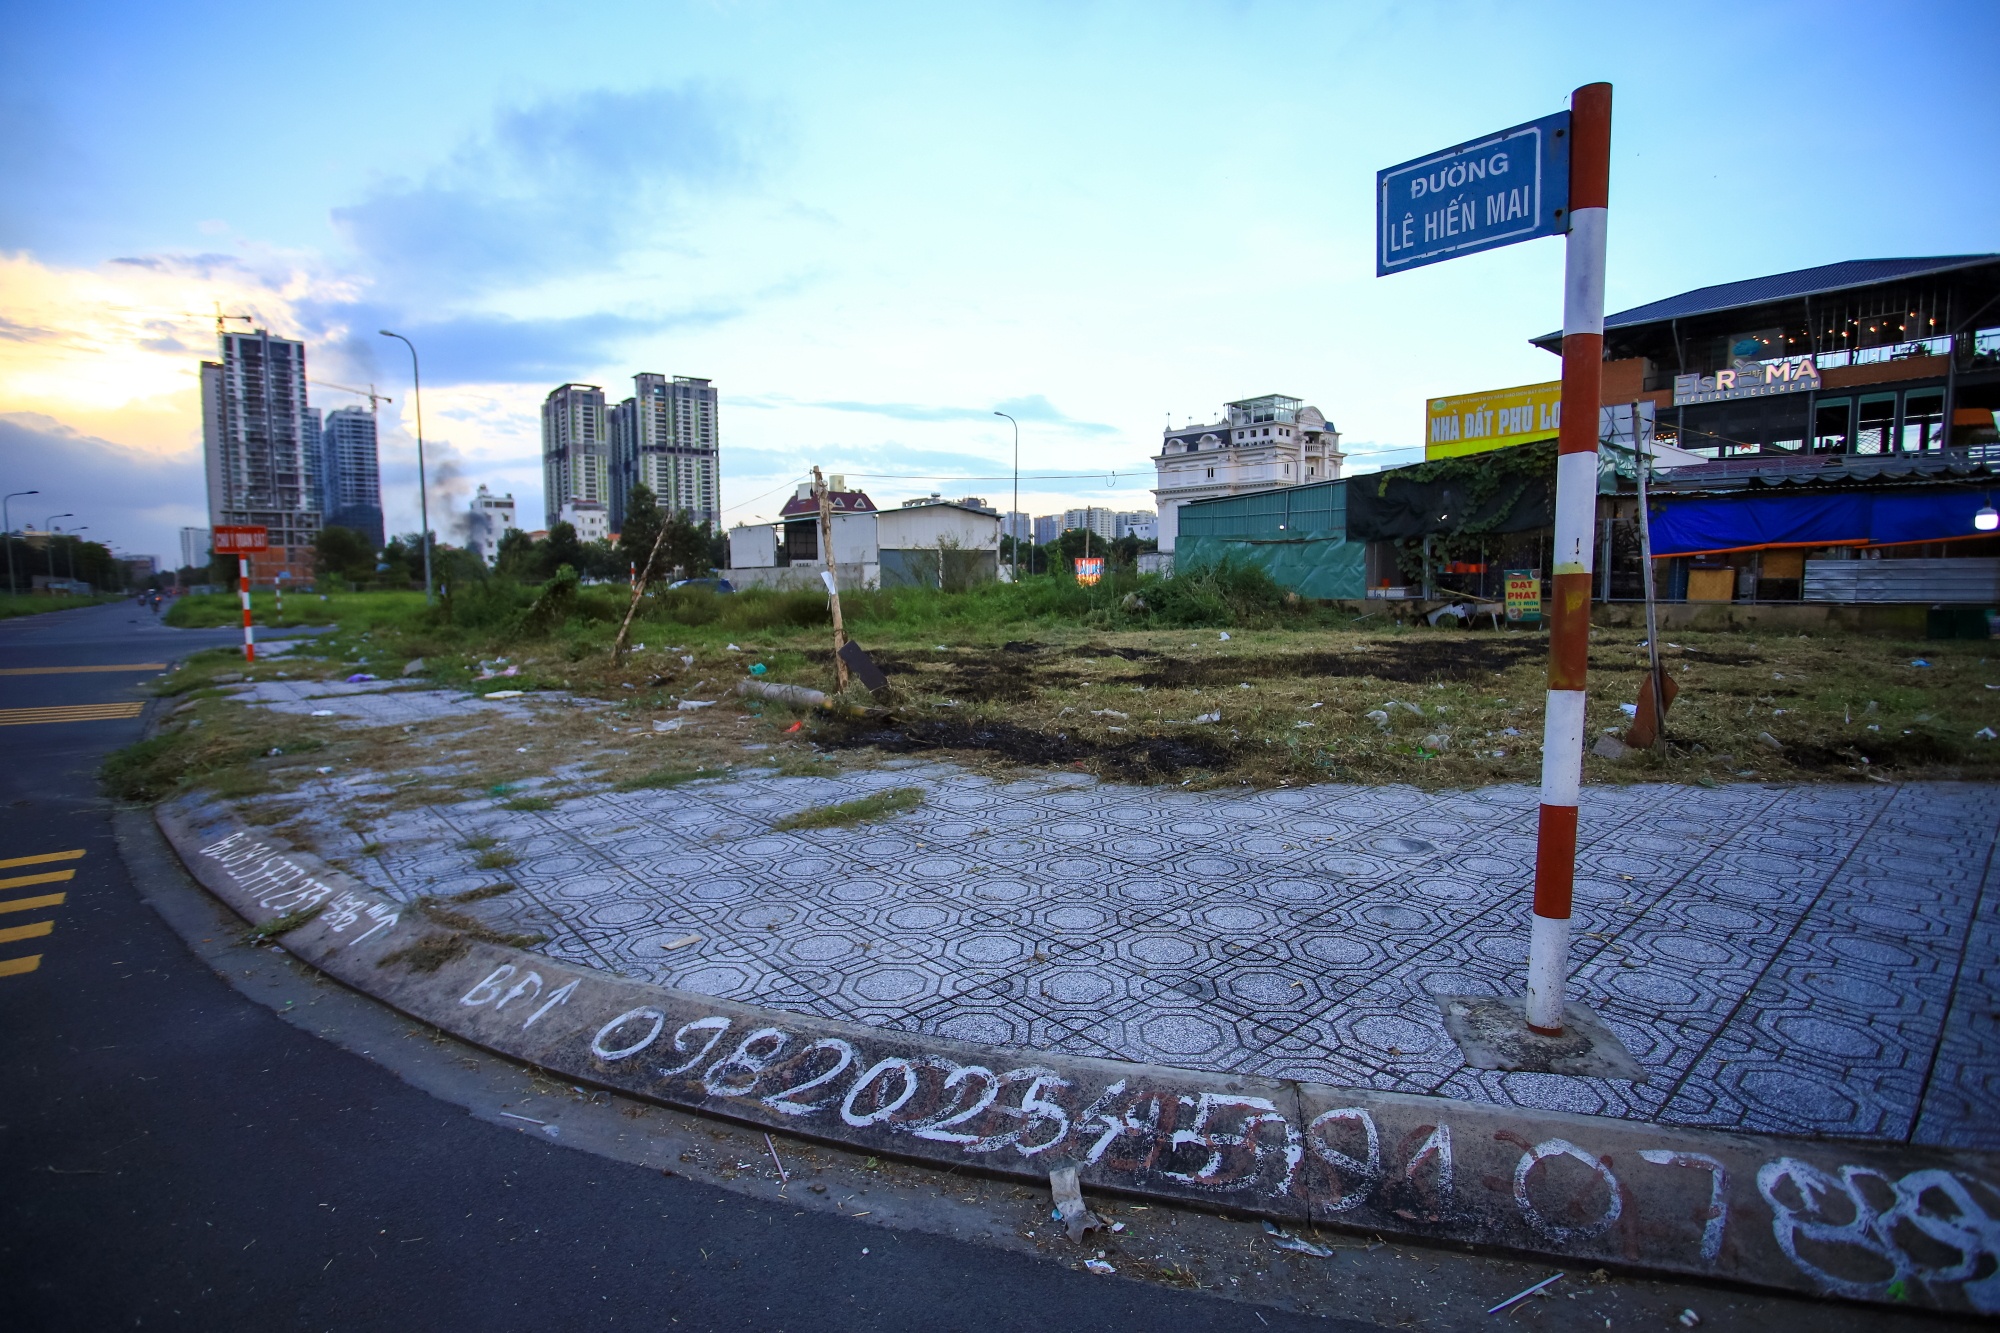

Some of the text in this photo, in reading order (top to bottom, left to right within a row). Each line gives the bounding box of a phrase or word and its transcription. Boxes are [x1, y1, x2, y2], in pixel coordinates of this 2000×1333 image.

[1410, 152, 1509, 200] ĐƯỜNG
[1390, 185, 1529, 252] LÊ HIẾN MAI
[1430, 409, 1459, 442] NHÀ
[1464, 403, 1494, 439] ĐẤT
[1498, 398, 1534, 435] PHÚ
